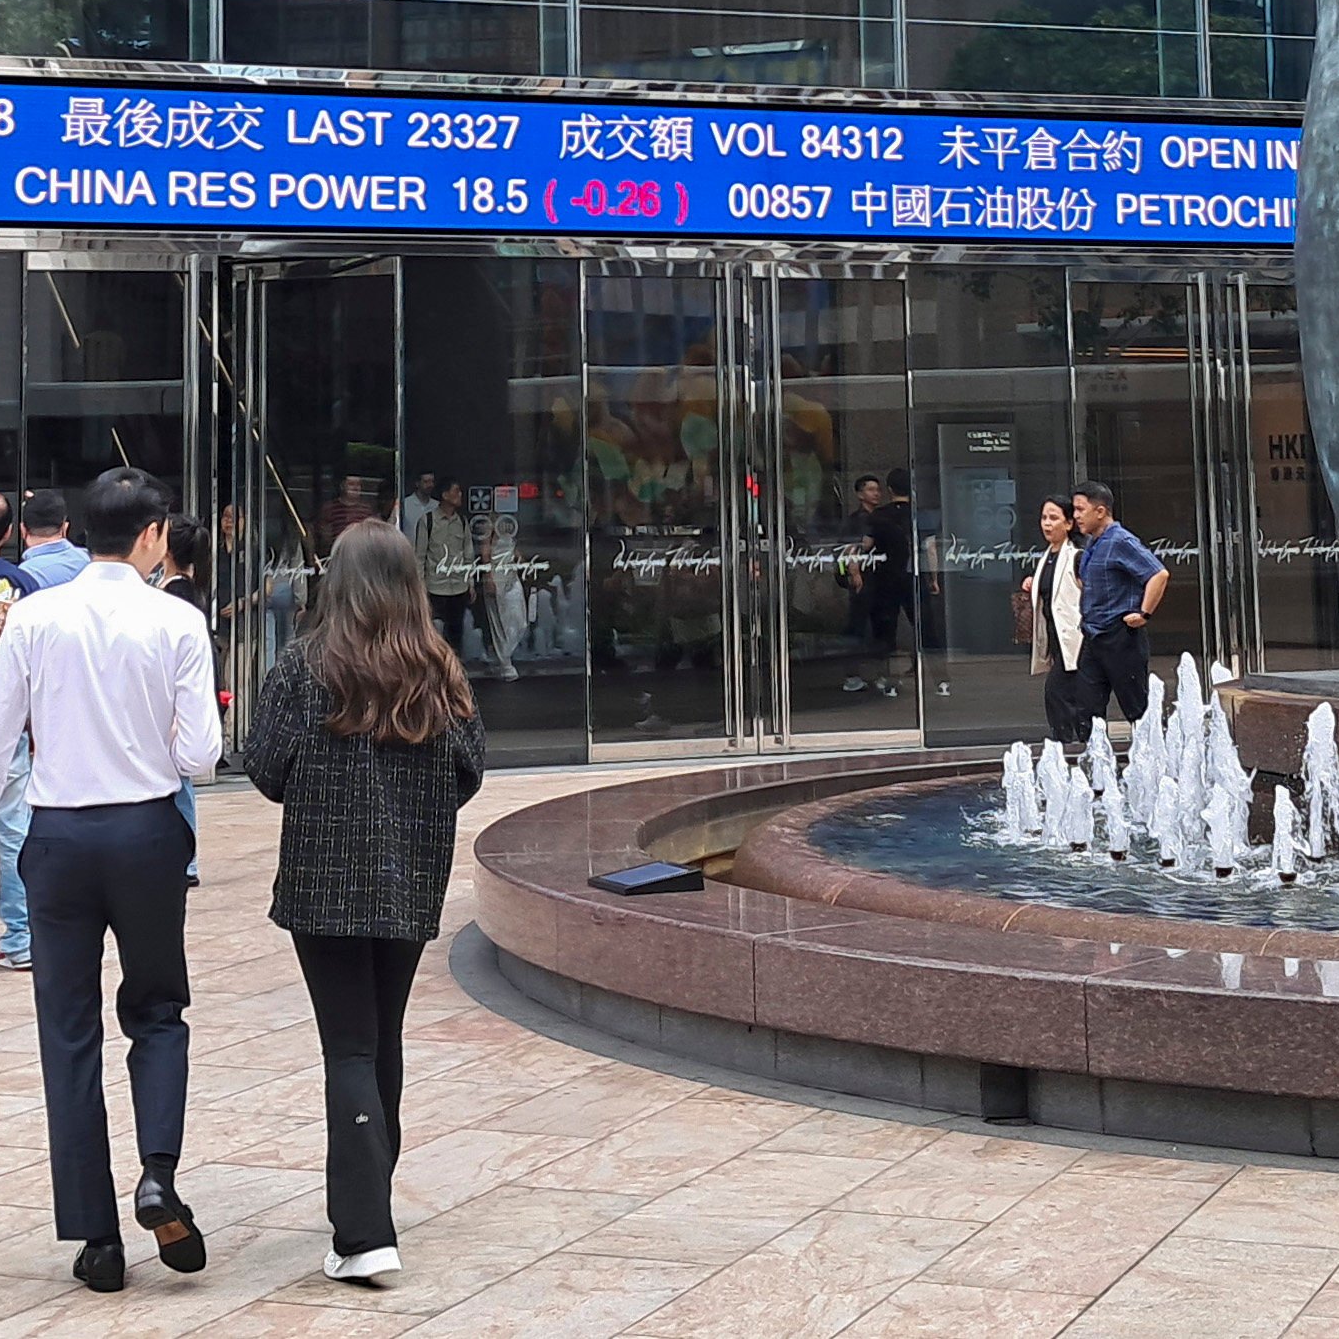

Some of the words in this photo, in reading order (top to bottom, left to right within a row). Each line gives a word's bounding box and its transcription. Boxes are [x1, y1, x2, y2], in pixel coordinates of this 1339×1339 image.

[61, 96, 264, 150] 最後成交
[288, 109, 392, 147] LAST
[408, 112, 519, 150] 23327
[559, 113, 694, 162] 成交額
[710, 122, 787, 157] VOL
[801, 125, 903, 160] 84312
[939, 125, 1142, 174] 未平倉合約
[1160, 135, 1257, 169] OPEN
[1267, 140, 1302, 170] IN
[15, 166, 157, 206] CHINA
[168, 170, 256, 209] RES
[269, 173, 427, 211] POWER
[452, 177, 528, 214] 18.5
[728, 183, 832, 220] 00857
[851, 182, 1098, 231] 中國石油股份
[1116, 192, 1295, 228] PETROCHI
